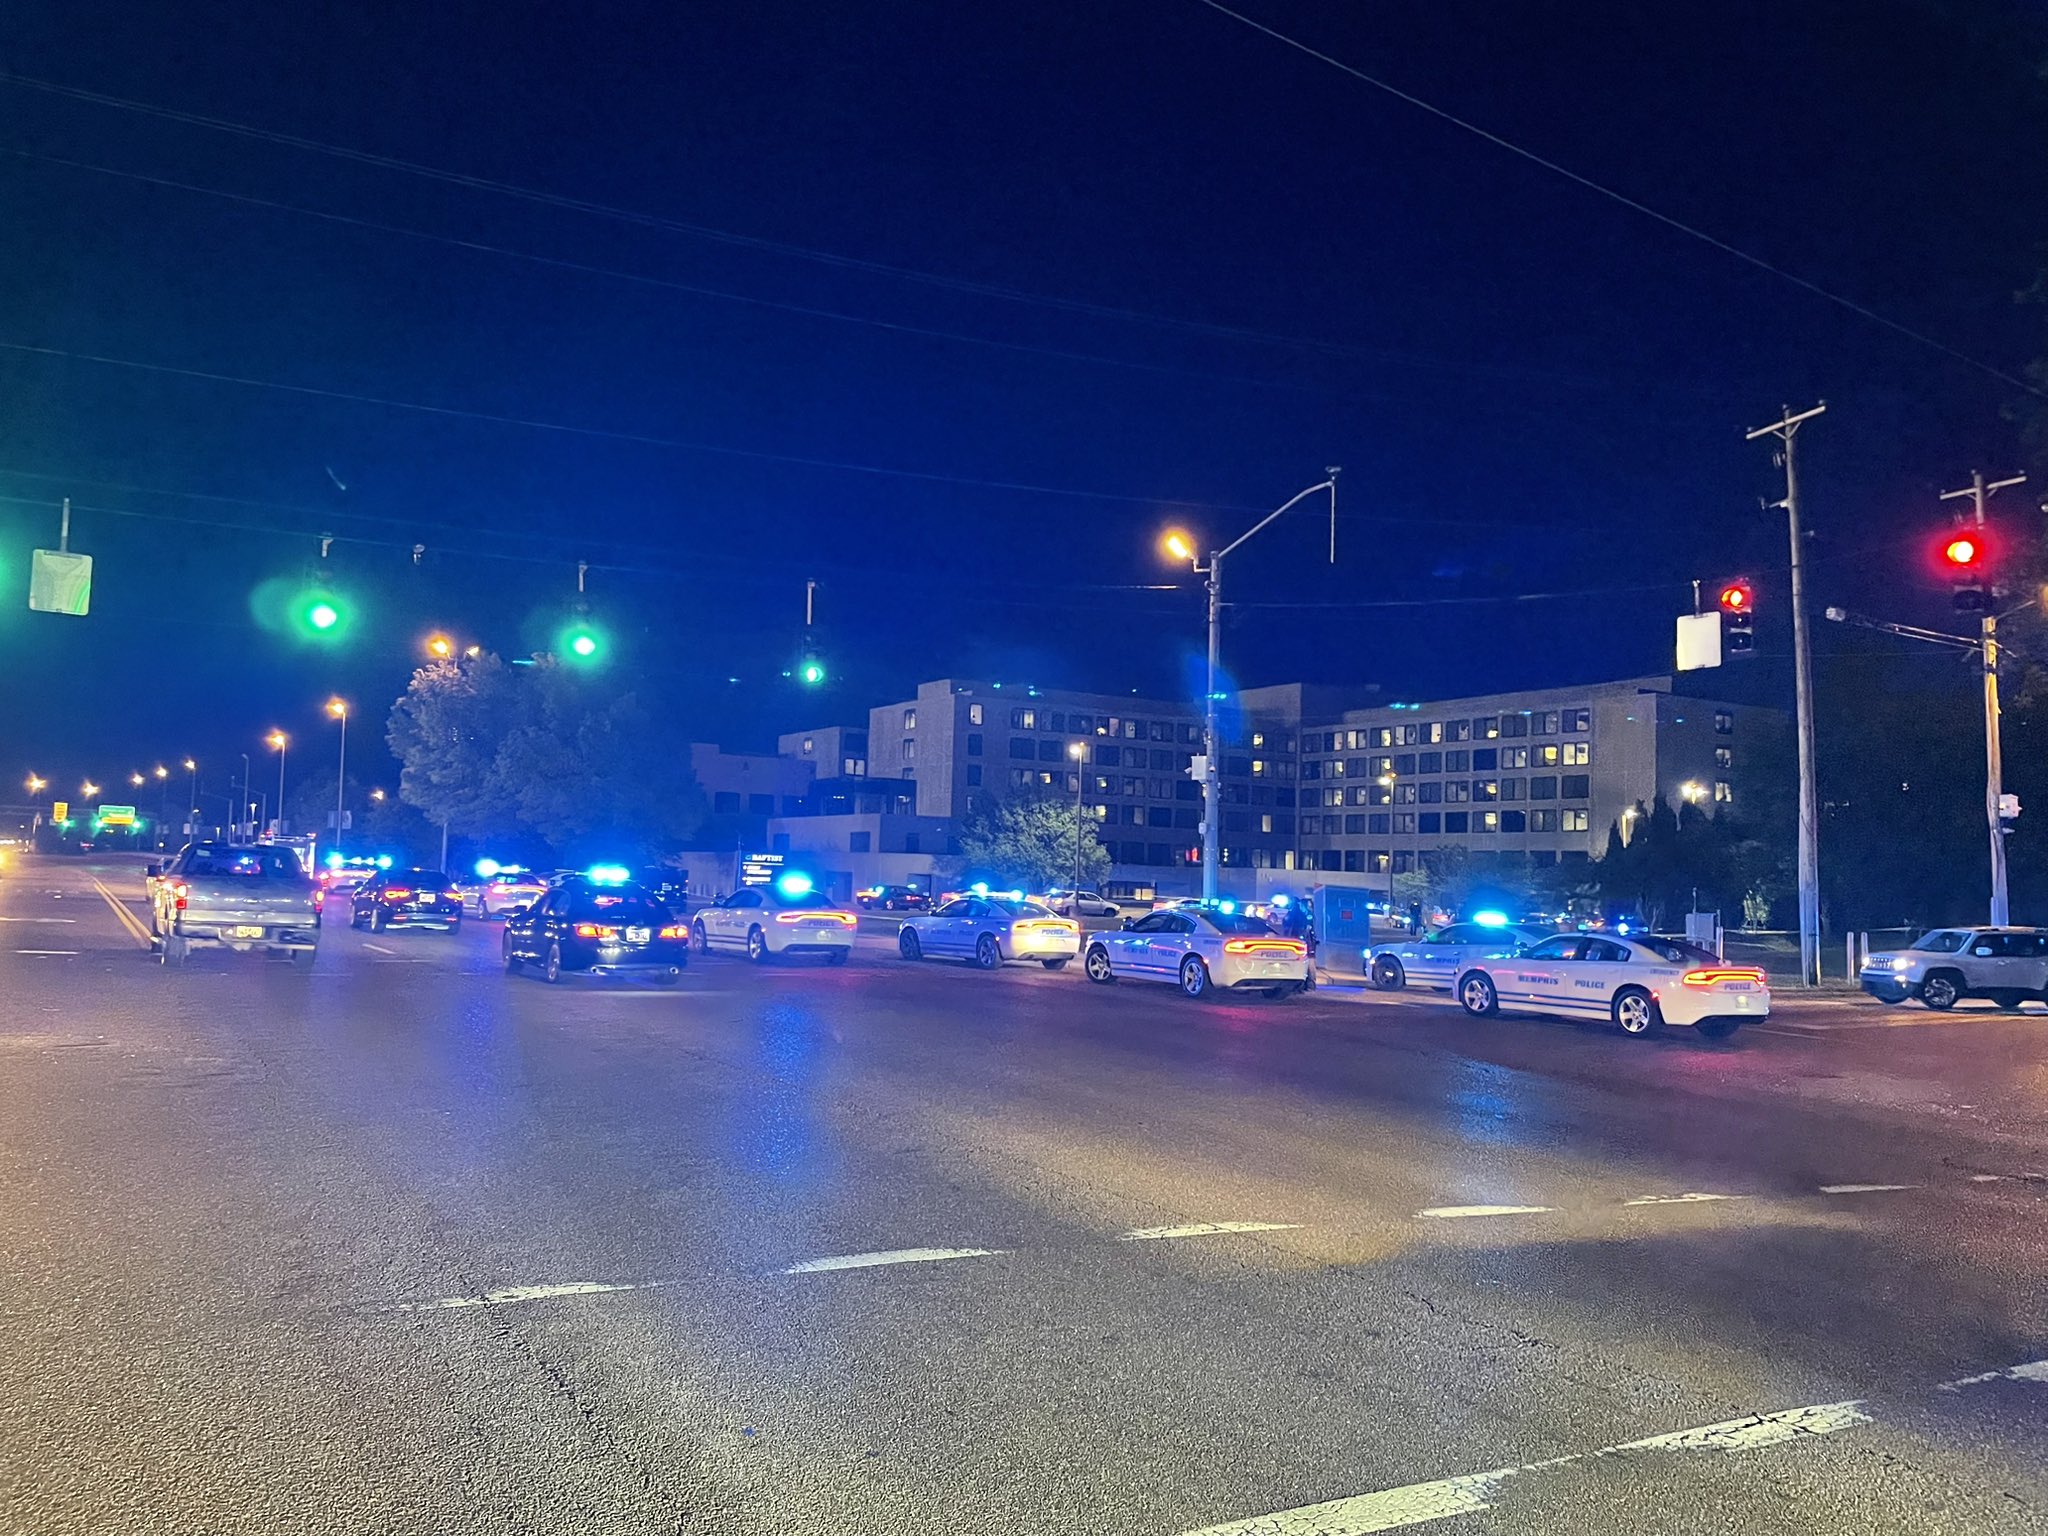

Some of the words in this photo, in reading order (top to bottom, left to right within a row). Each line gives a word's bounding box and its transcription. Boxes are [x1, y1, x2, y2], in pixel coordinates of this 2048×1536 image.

[1518, 975, 1559, 986] MEMPHIS
[1574, 979, 1605, 989] POLICE
[1723, 982, 1752, 991] POLICE
